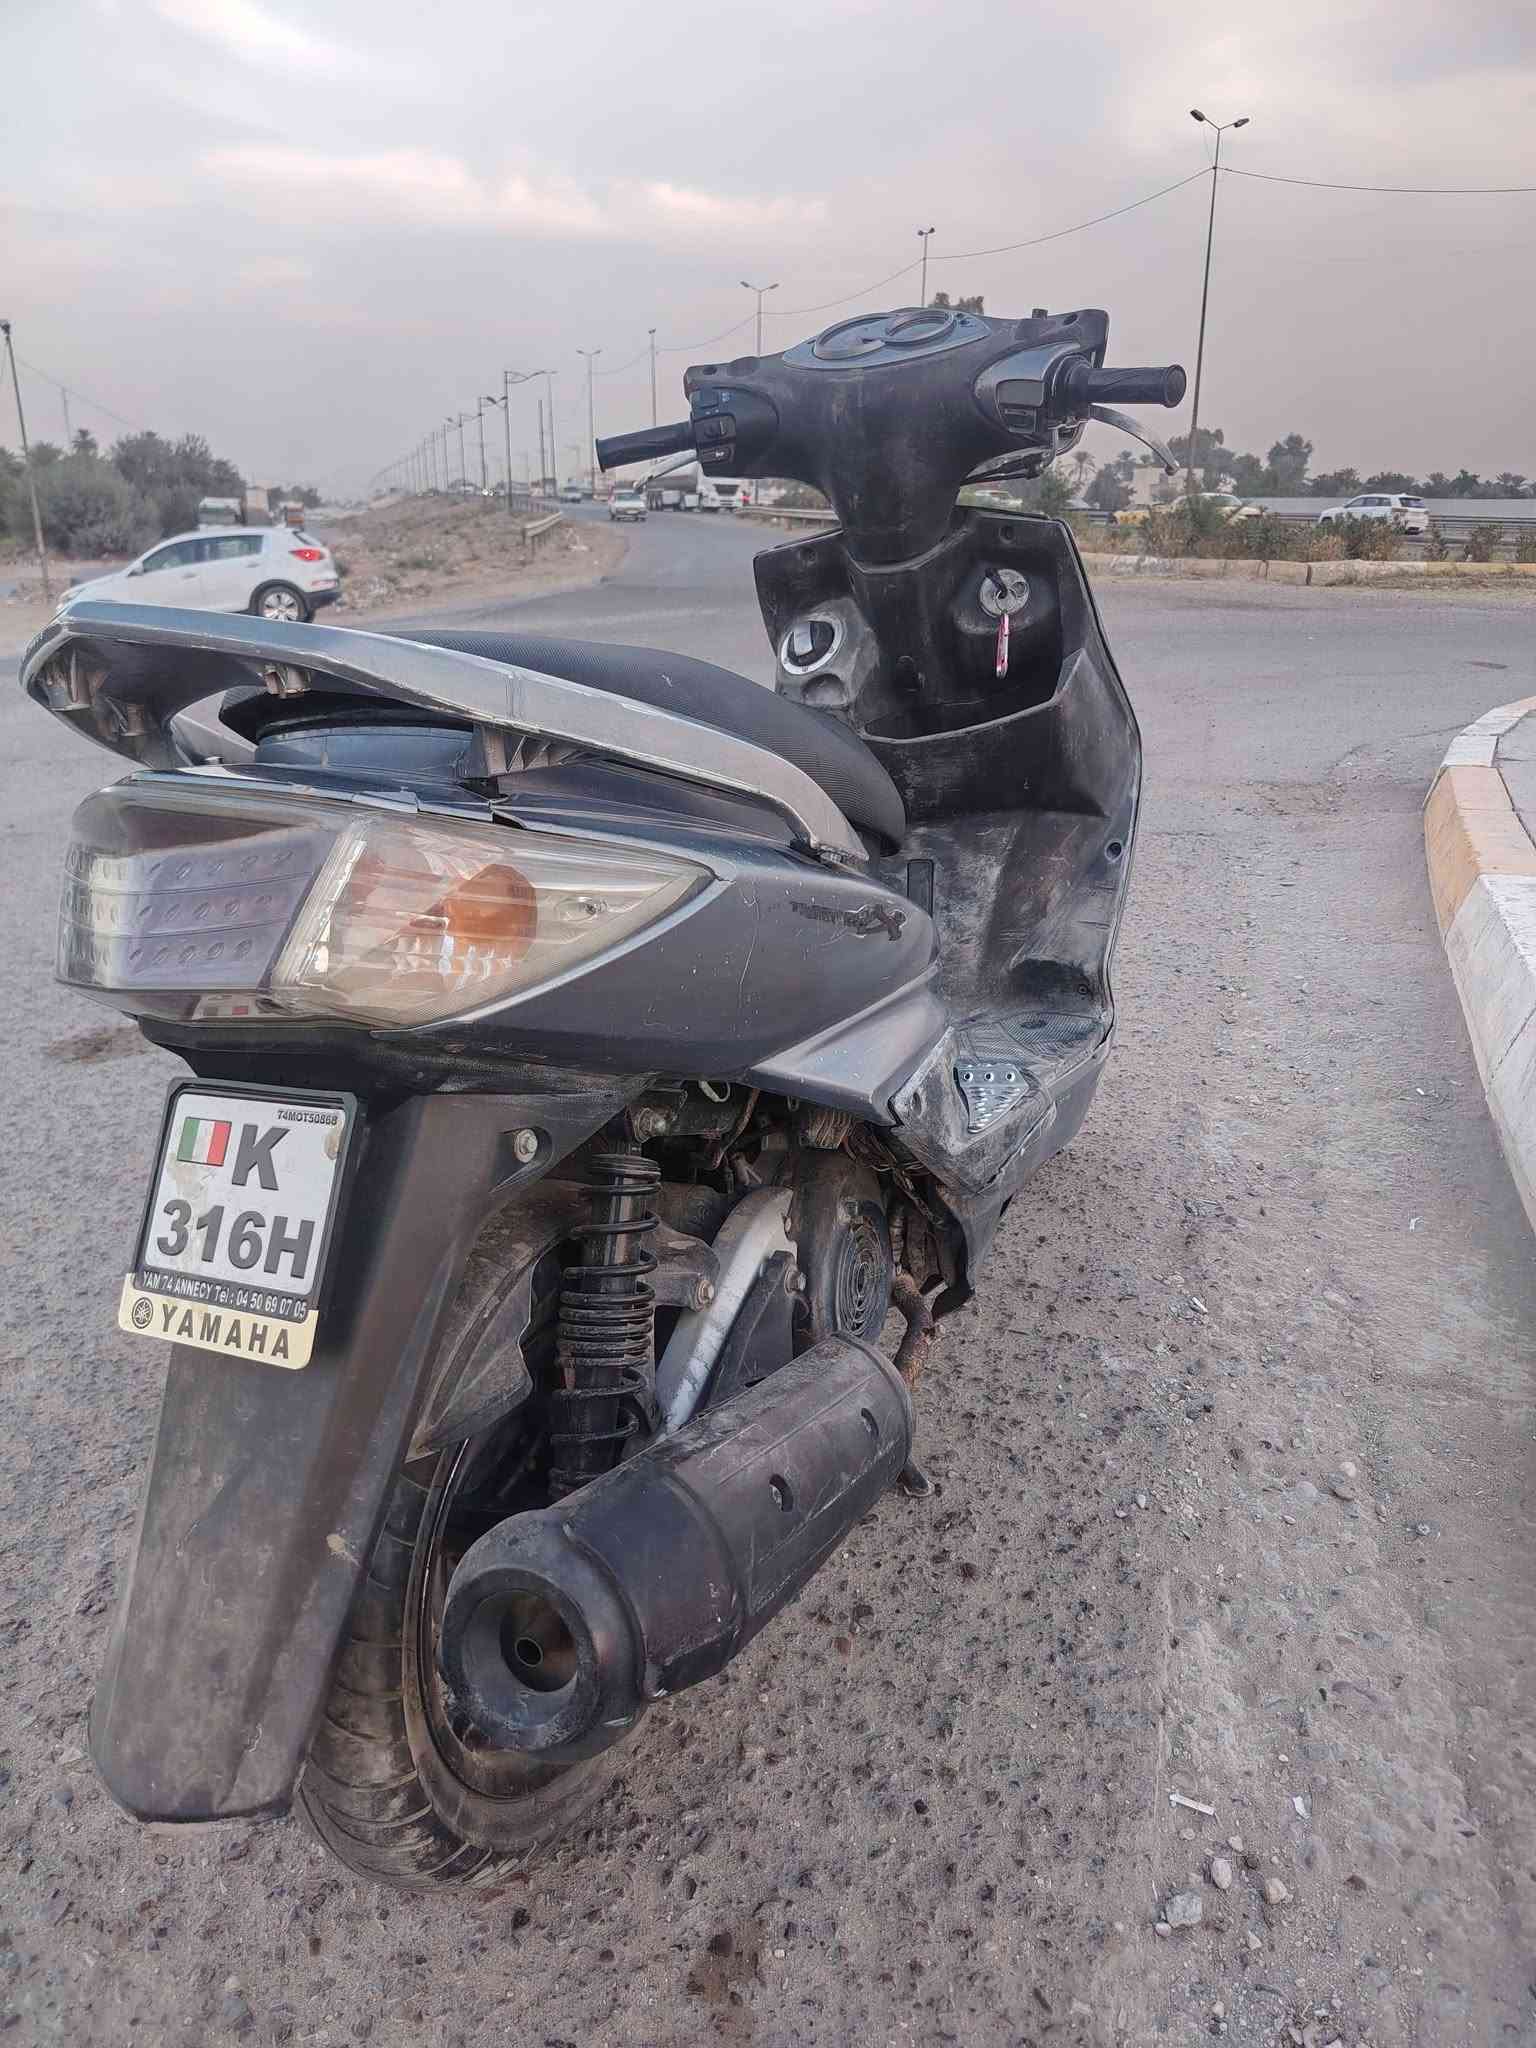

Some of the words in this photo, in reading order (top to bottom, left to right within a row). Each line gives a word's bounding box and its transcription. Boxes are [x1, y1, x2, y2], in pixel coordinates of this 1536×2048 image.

[231, 1123, 291, 1190] K
[156, 1199, 315, 1279] 316H
[143, 1270, 161, 1289] YAM
[161, 1275, 173, 1291] 74
[174, 1279, 213, 1299] ANNECY
[236, 1289, 249, 1307] 04
[250, 1292, 263, 1310] 50
[264, 1295, 278, 1313] 69
[279, 1298, 293, 1316] 07
[294, 1300, 307, 1318] 05
[161, 1303, 290, 1360] YAMAHA
